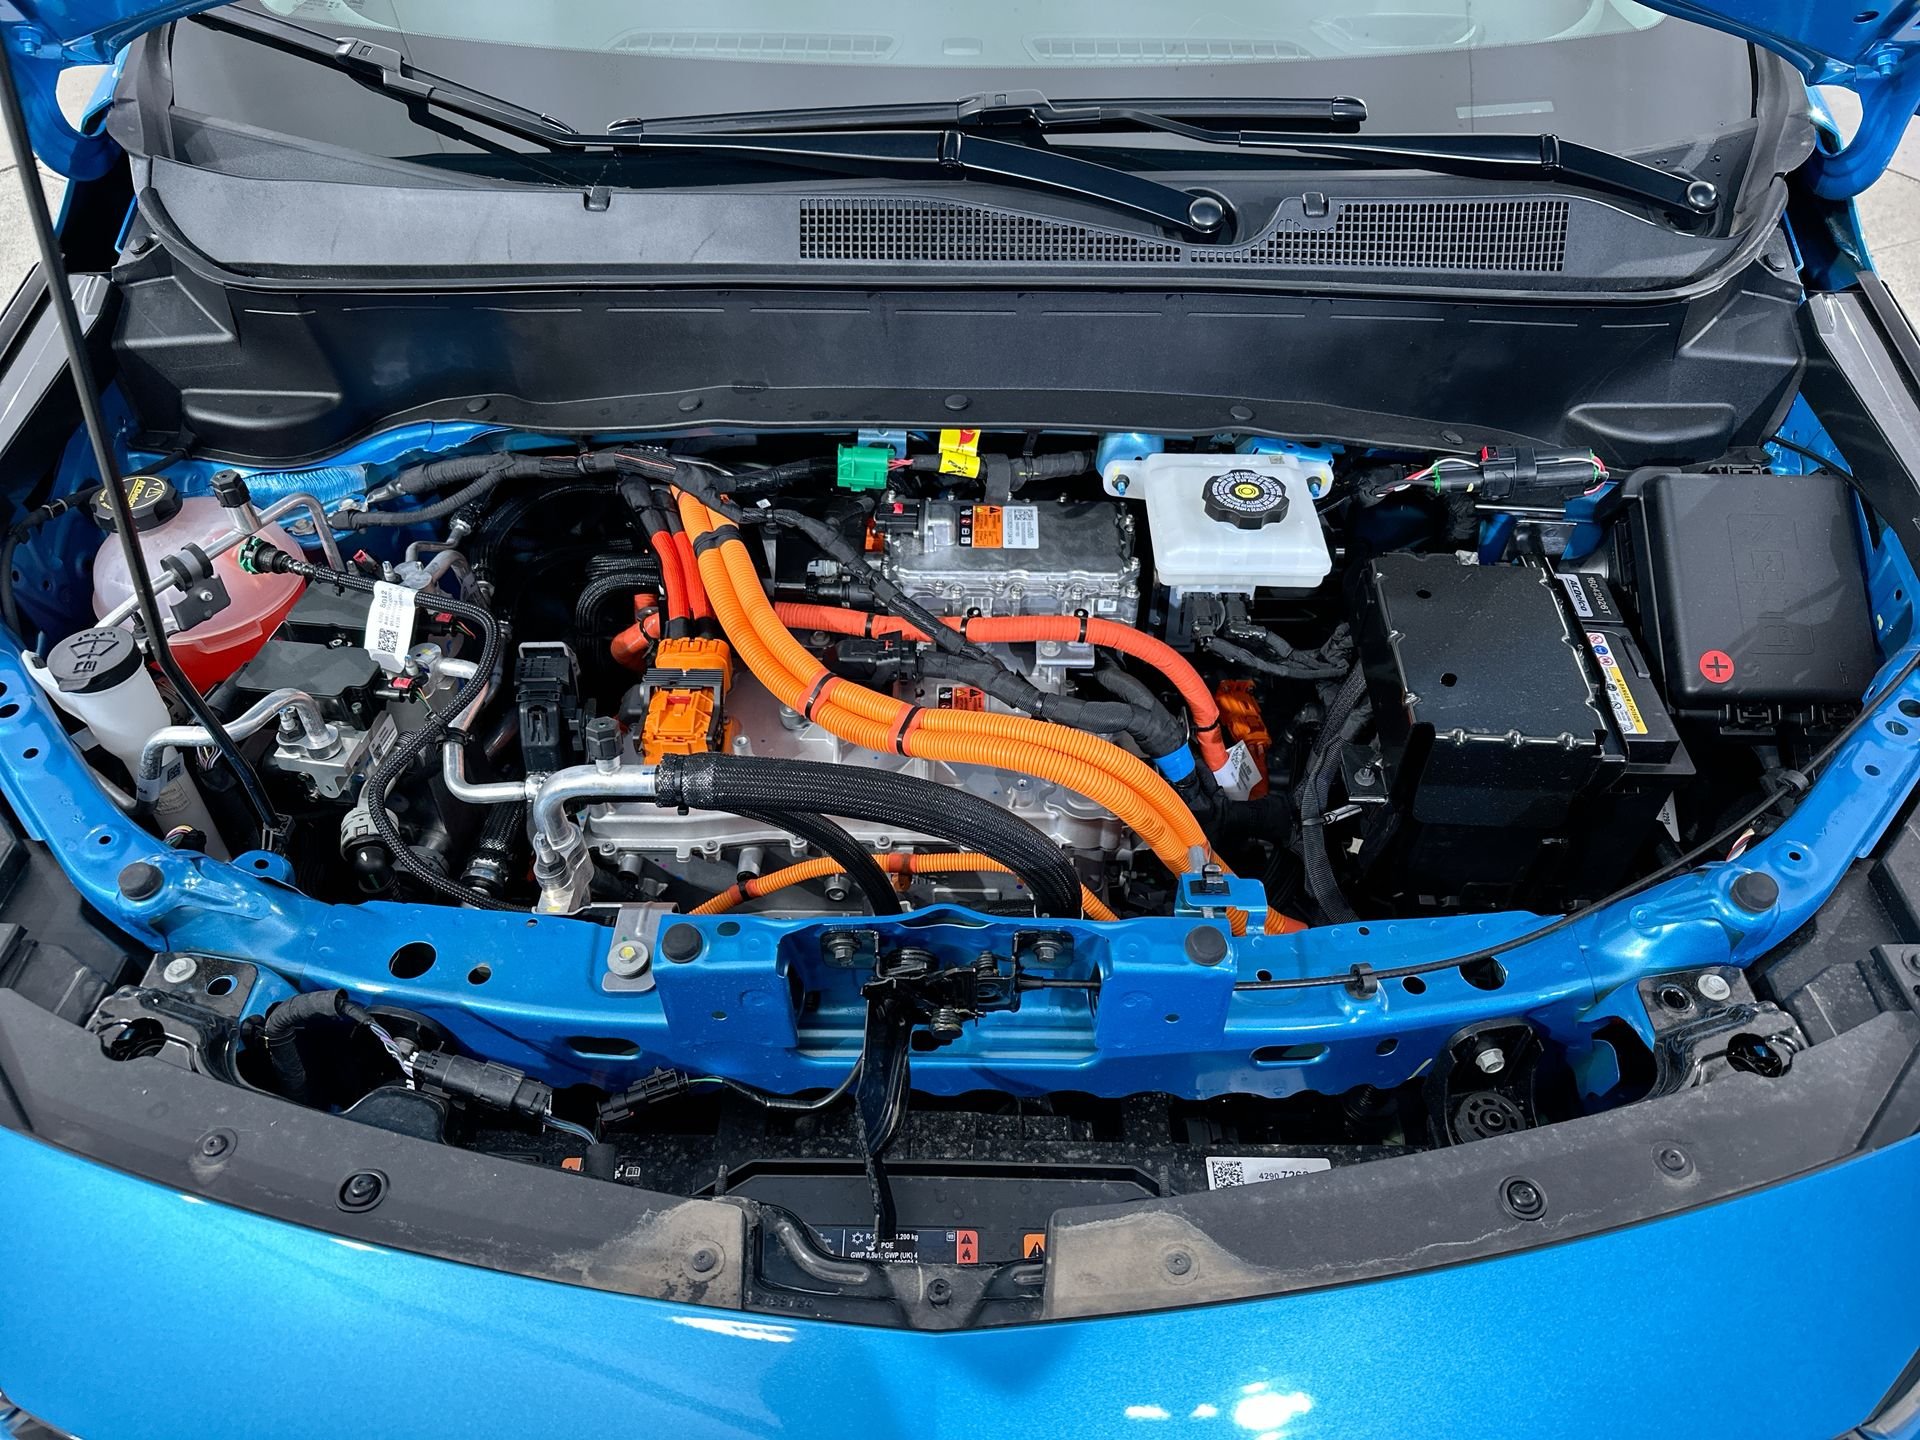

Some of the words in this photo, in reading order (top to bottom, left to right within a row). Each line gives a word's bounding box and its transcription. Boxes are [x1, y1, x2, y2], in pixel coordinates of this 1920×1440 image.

[1569, 578, 1588, 612] ACDelco
[911, 1233, 919, 1241] kg
[899, 1251, 913, 1259] (UK)
